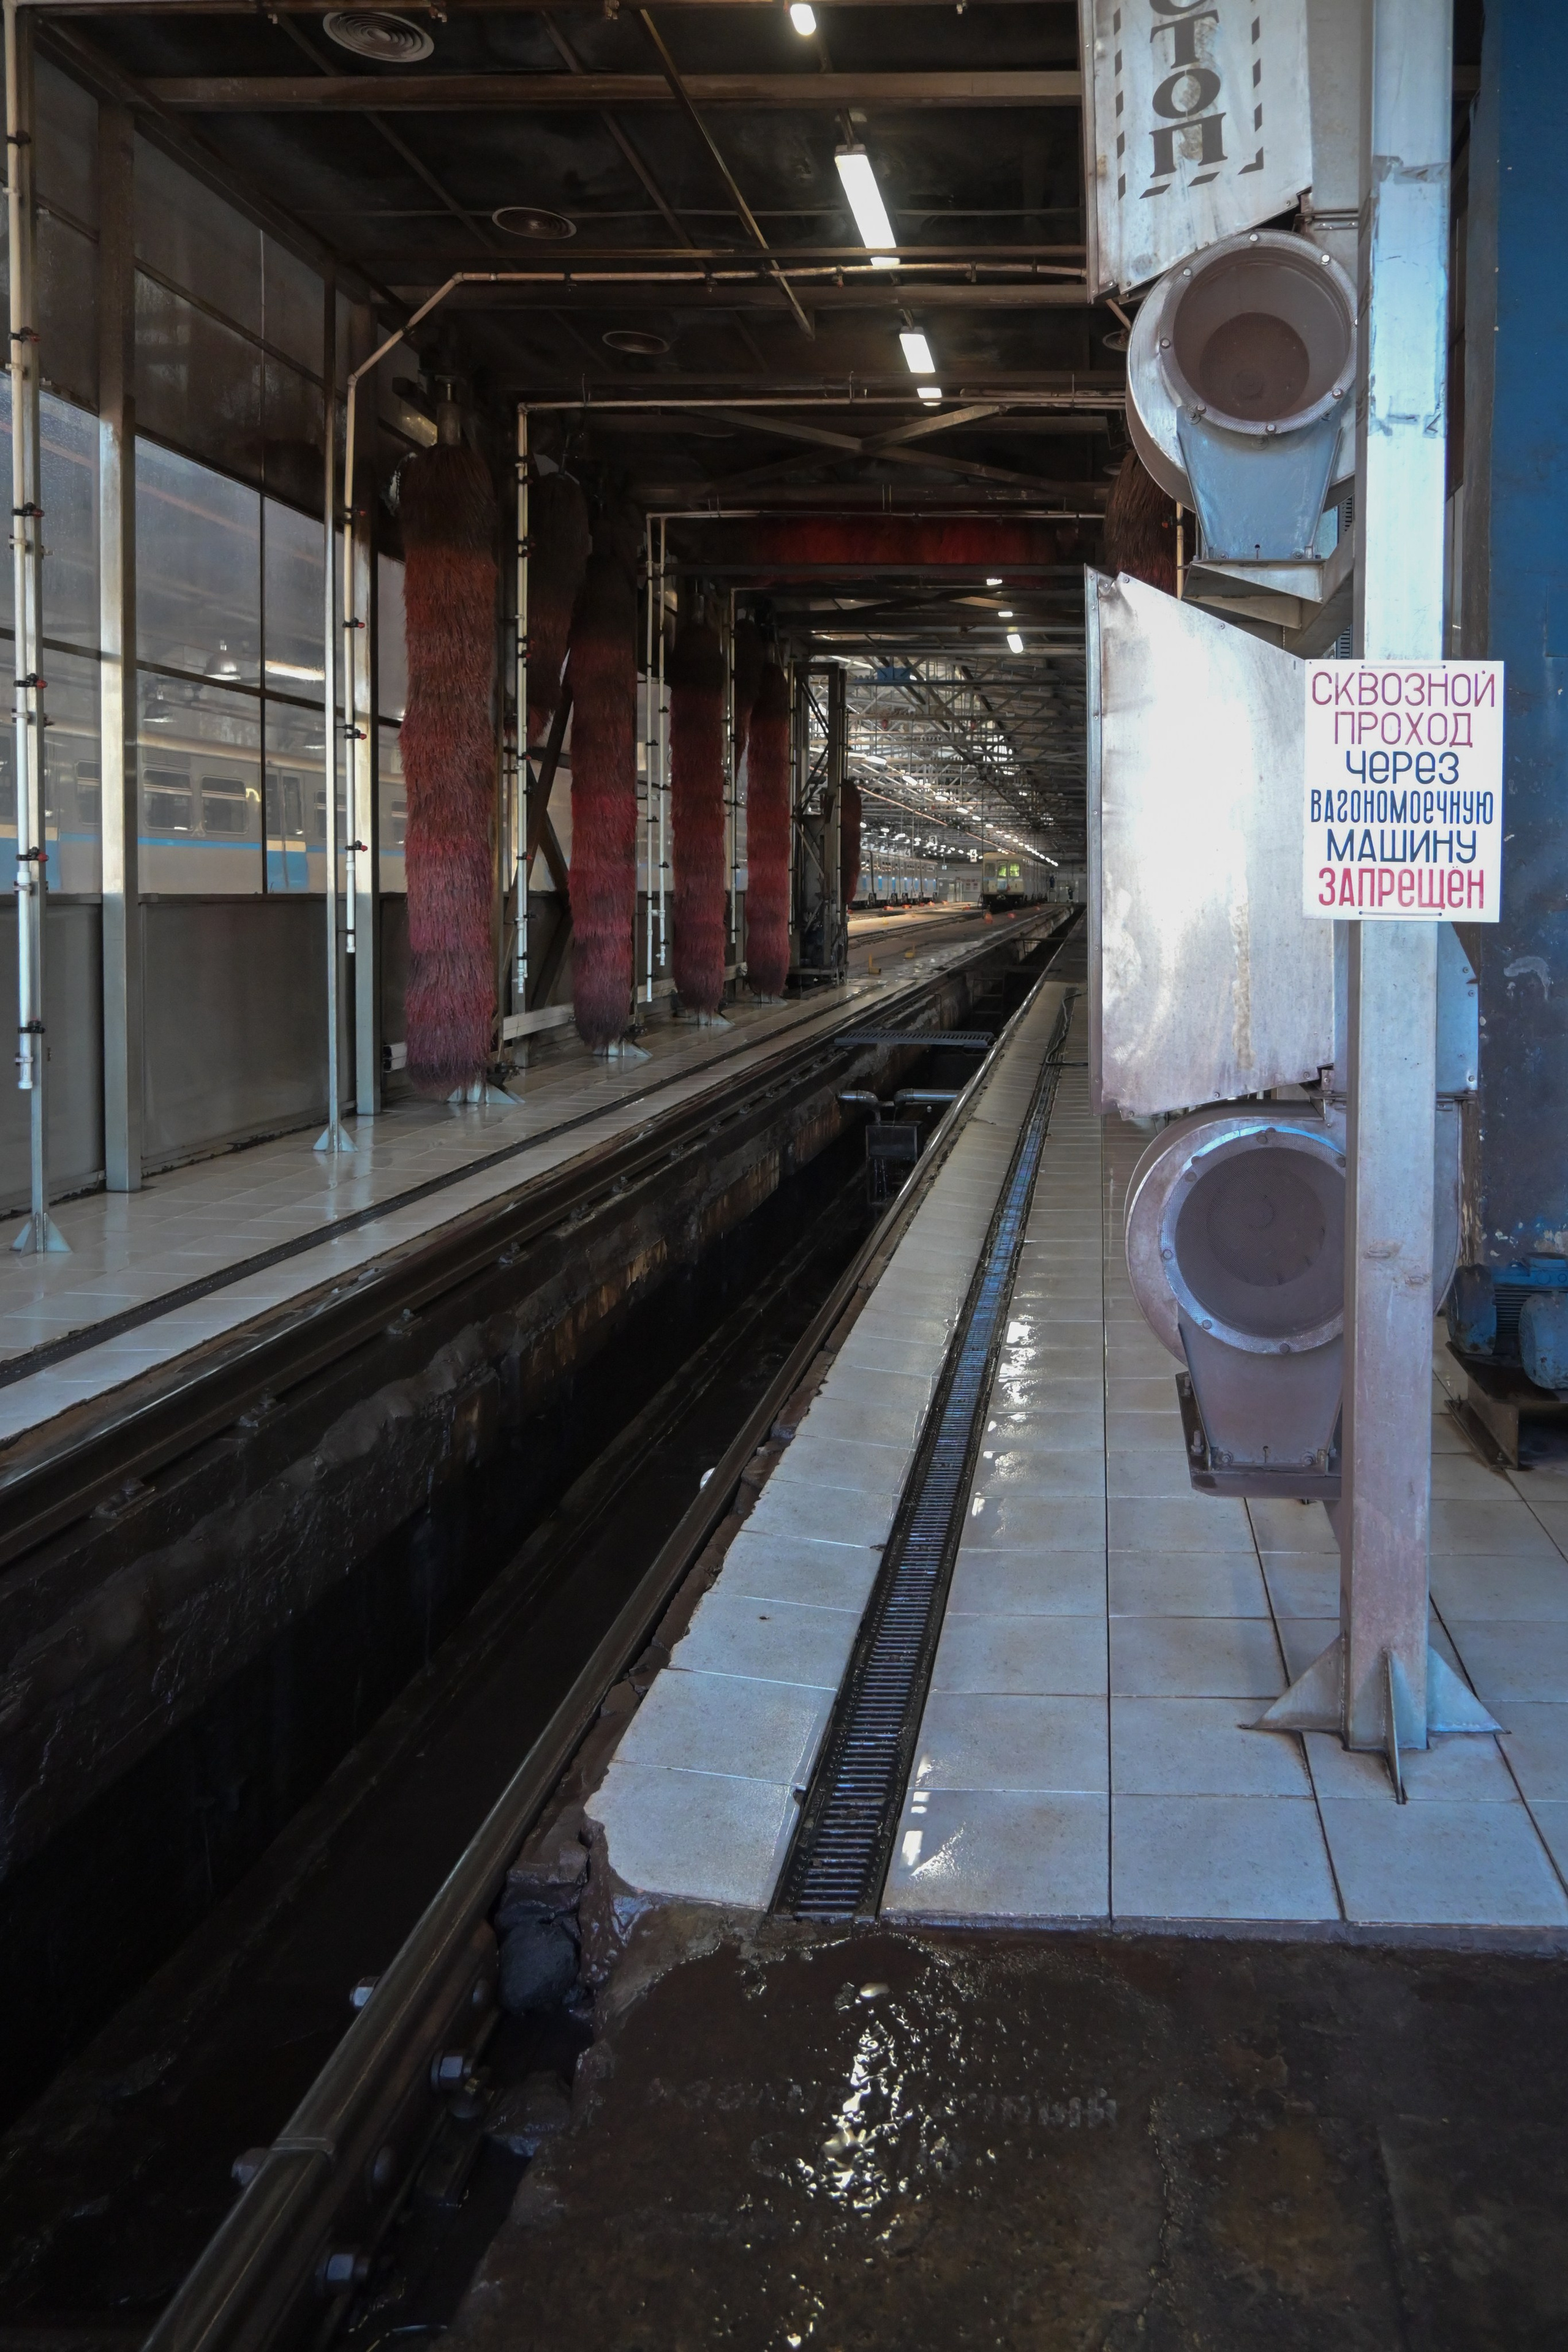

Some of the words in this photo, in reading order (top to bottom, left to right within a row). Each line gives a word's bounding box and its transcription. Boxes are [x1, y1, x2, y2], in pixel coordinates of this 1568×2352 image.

[1312, 670, 1495, 707] СКВОЗНОЙ
[1334, 711, 1473, 748] ПРОХОД
[1327, 828, 1477, 864] МАШИНУ
